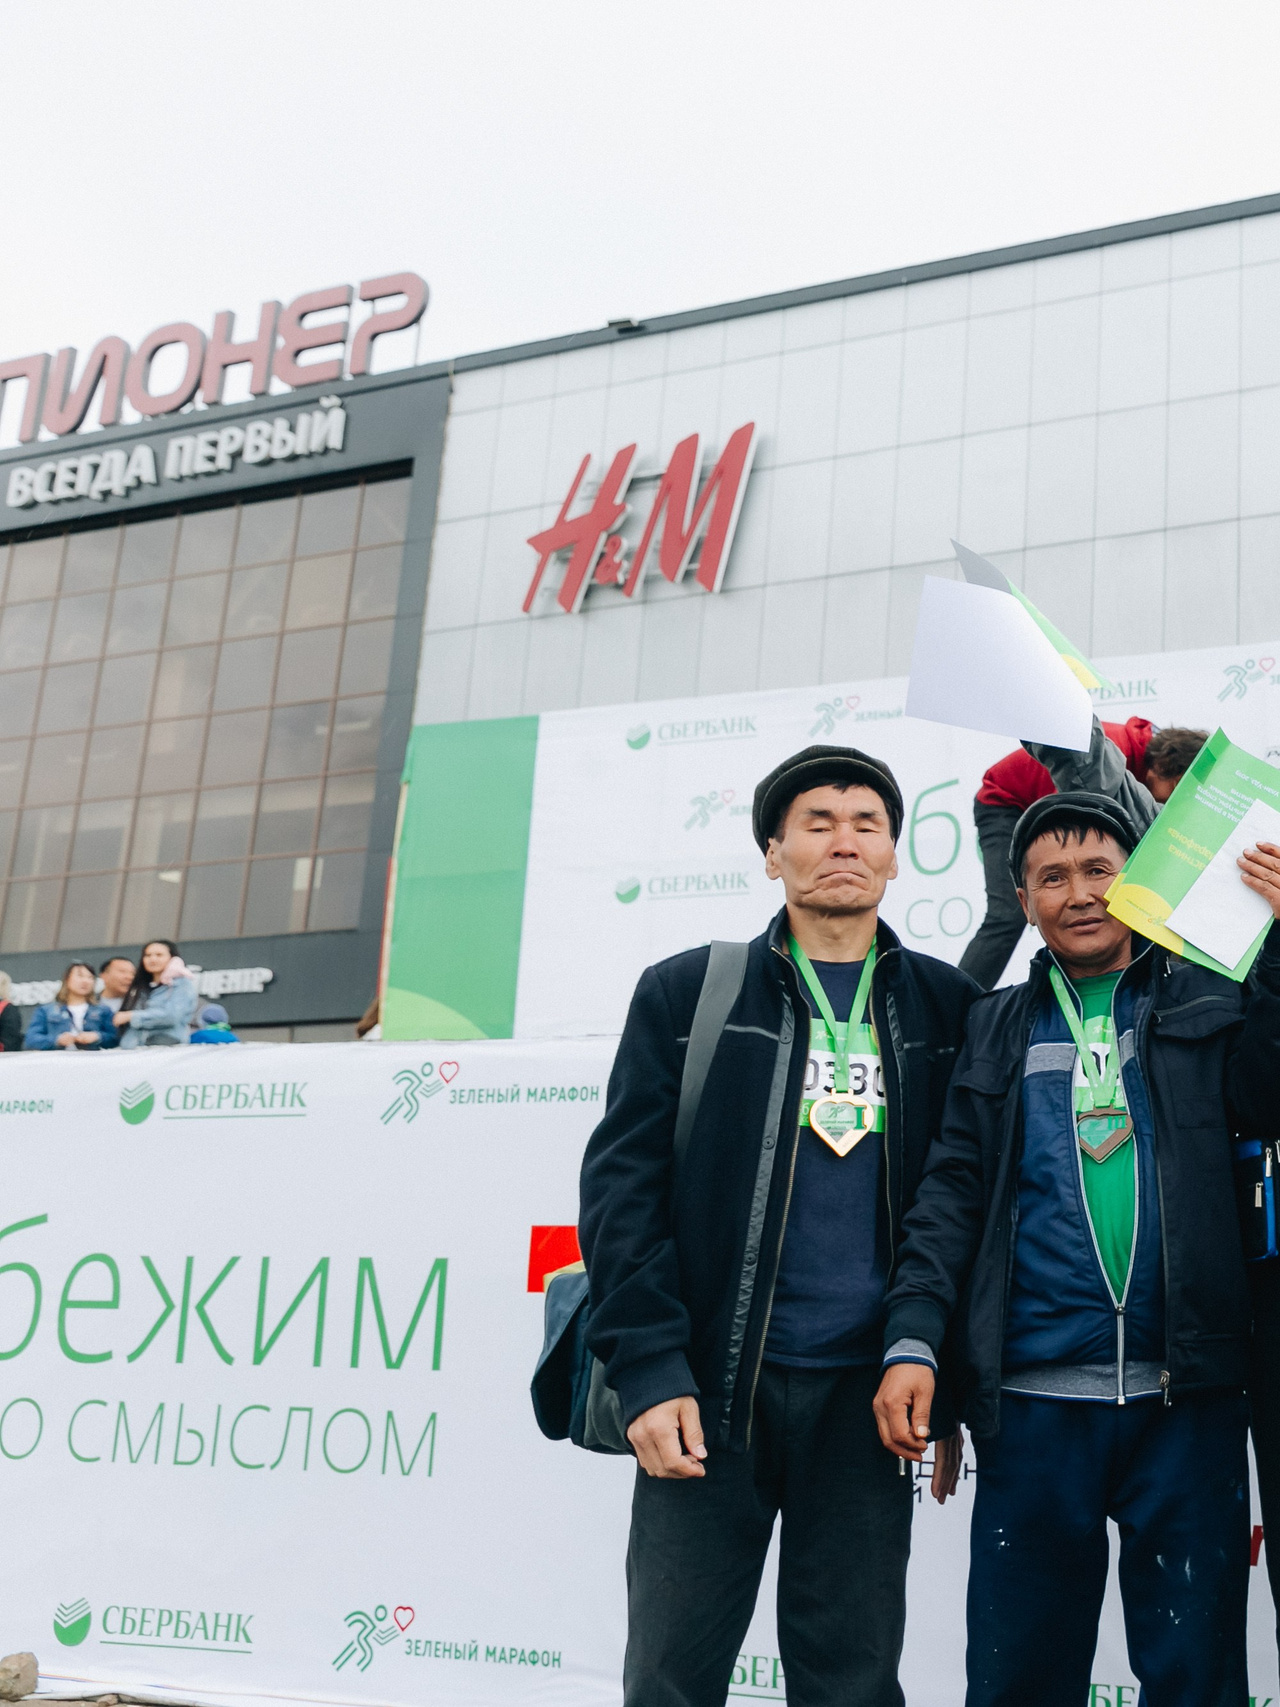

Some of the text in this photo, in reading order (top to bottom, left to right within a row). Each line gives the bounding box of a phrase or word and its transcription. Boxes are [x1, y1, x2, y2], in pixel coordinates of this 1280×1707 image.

[6, 395, 346, 508] ВСЕГДА ПЕРВЫЙ
[521, 422, 757, 614] H&M
[657, 716, 757, 742] СБЕРБАНК
[1167, 843, 1207, 872] астника
[648, 872, 750, 895] СБЕРБАНК
[0, 1099, 54, 1114] АРАФОН
[165, 1080, 309, 1111] СБЕРБАНК
[449, 1084, 600, 1104] ЗЕЛЕНЫЙ МАРАФОН
[0, 1213, 449, 1371] бежим
[101, 1603, 255, 1644] СБЕРБАНК
[404, 1638, 562, 1669] ЗЕЛЕНЫЙ МАРАФОН
